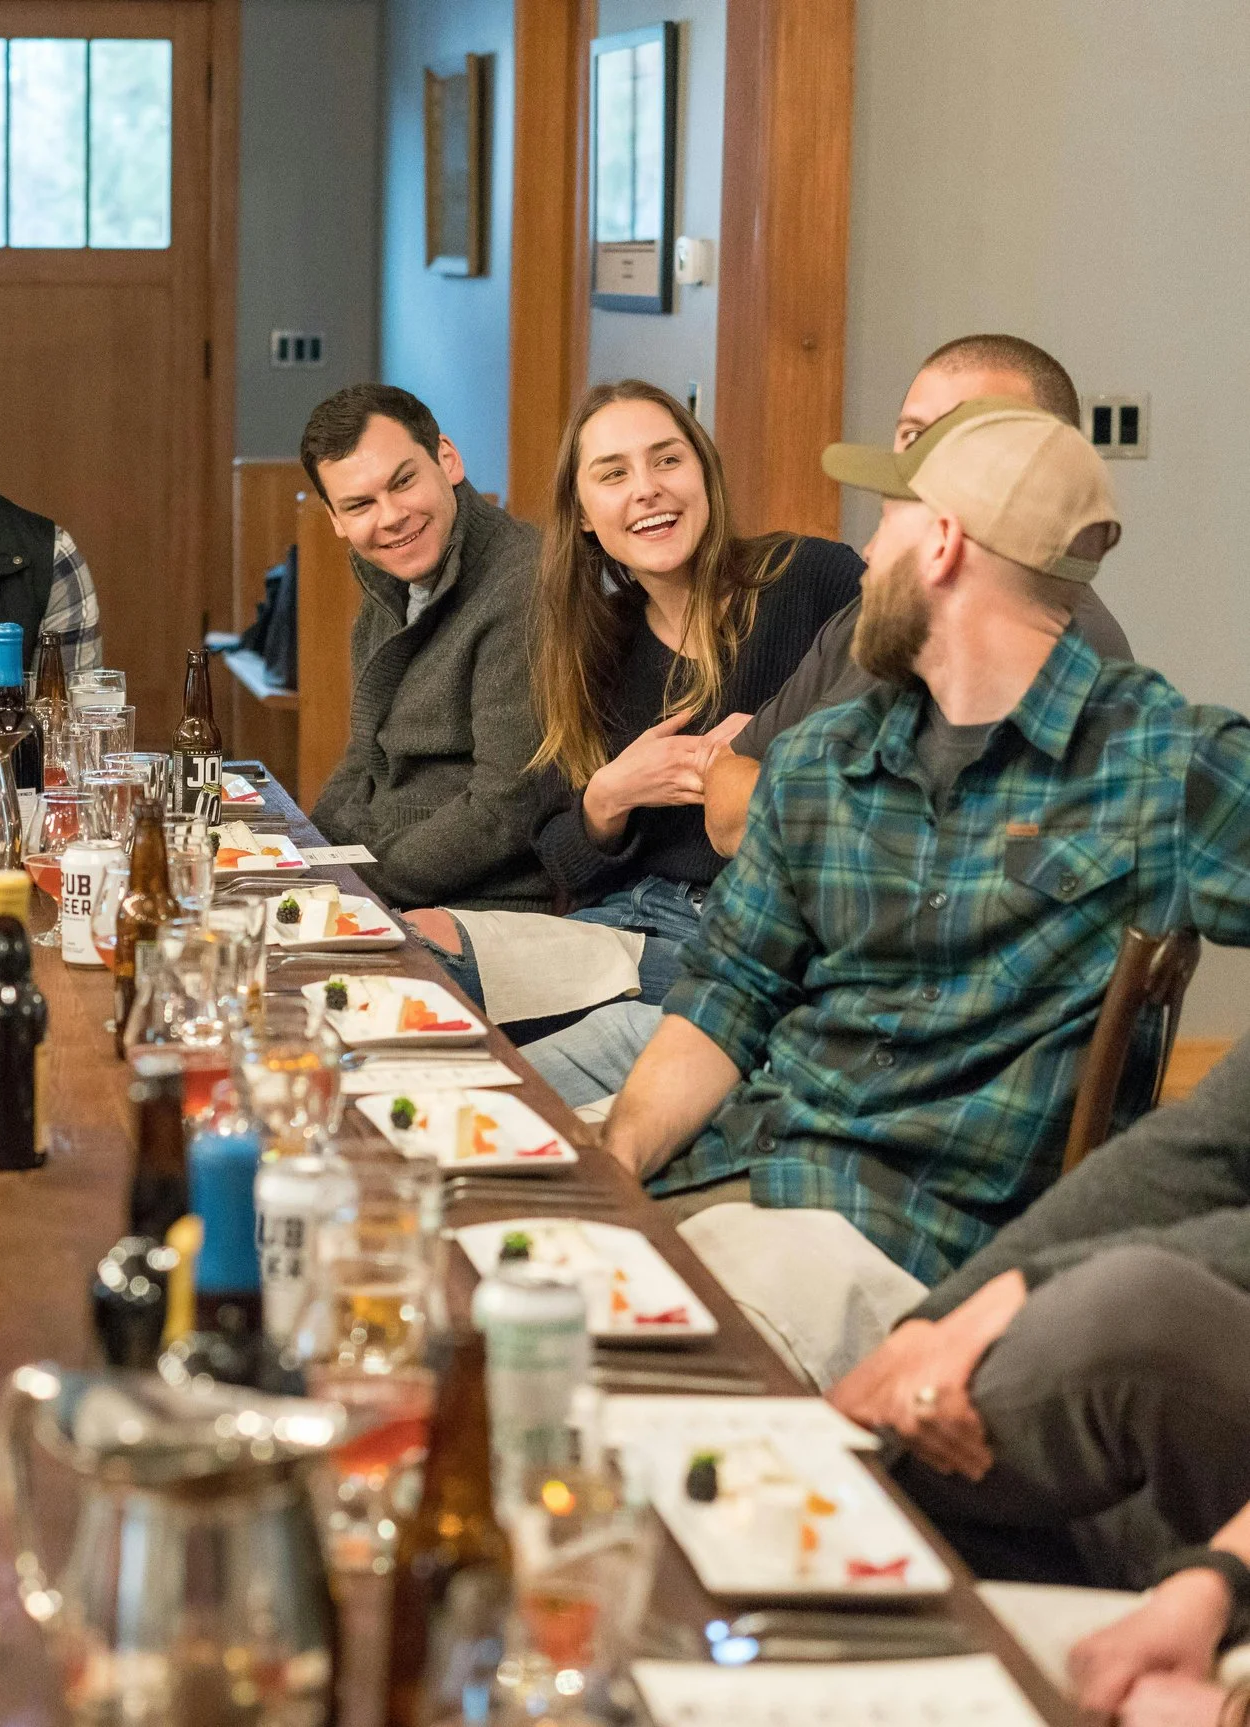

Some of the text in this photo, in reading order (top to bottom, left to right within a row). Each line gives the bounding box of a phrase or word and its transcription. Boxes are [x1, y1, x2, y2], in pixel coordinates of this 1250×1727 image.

[187, 757, 222, 787] JO
[61, 871, 91, 896] UB
[64, 897, 91, 916] EER
